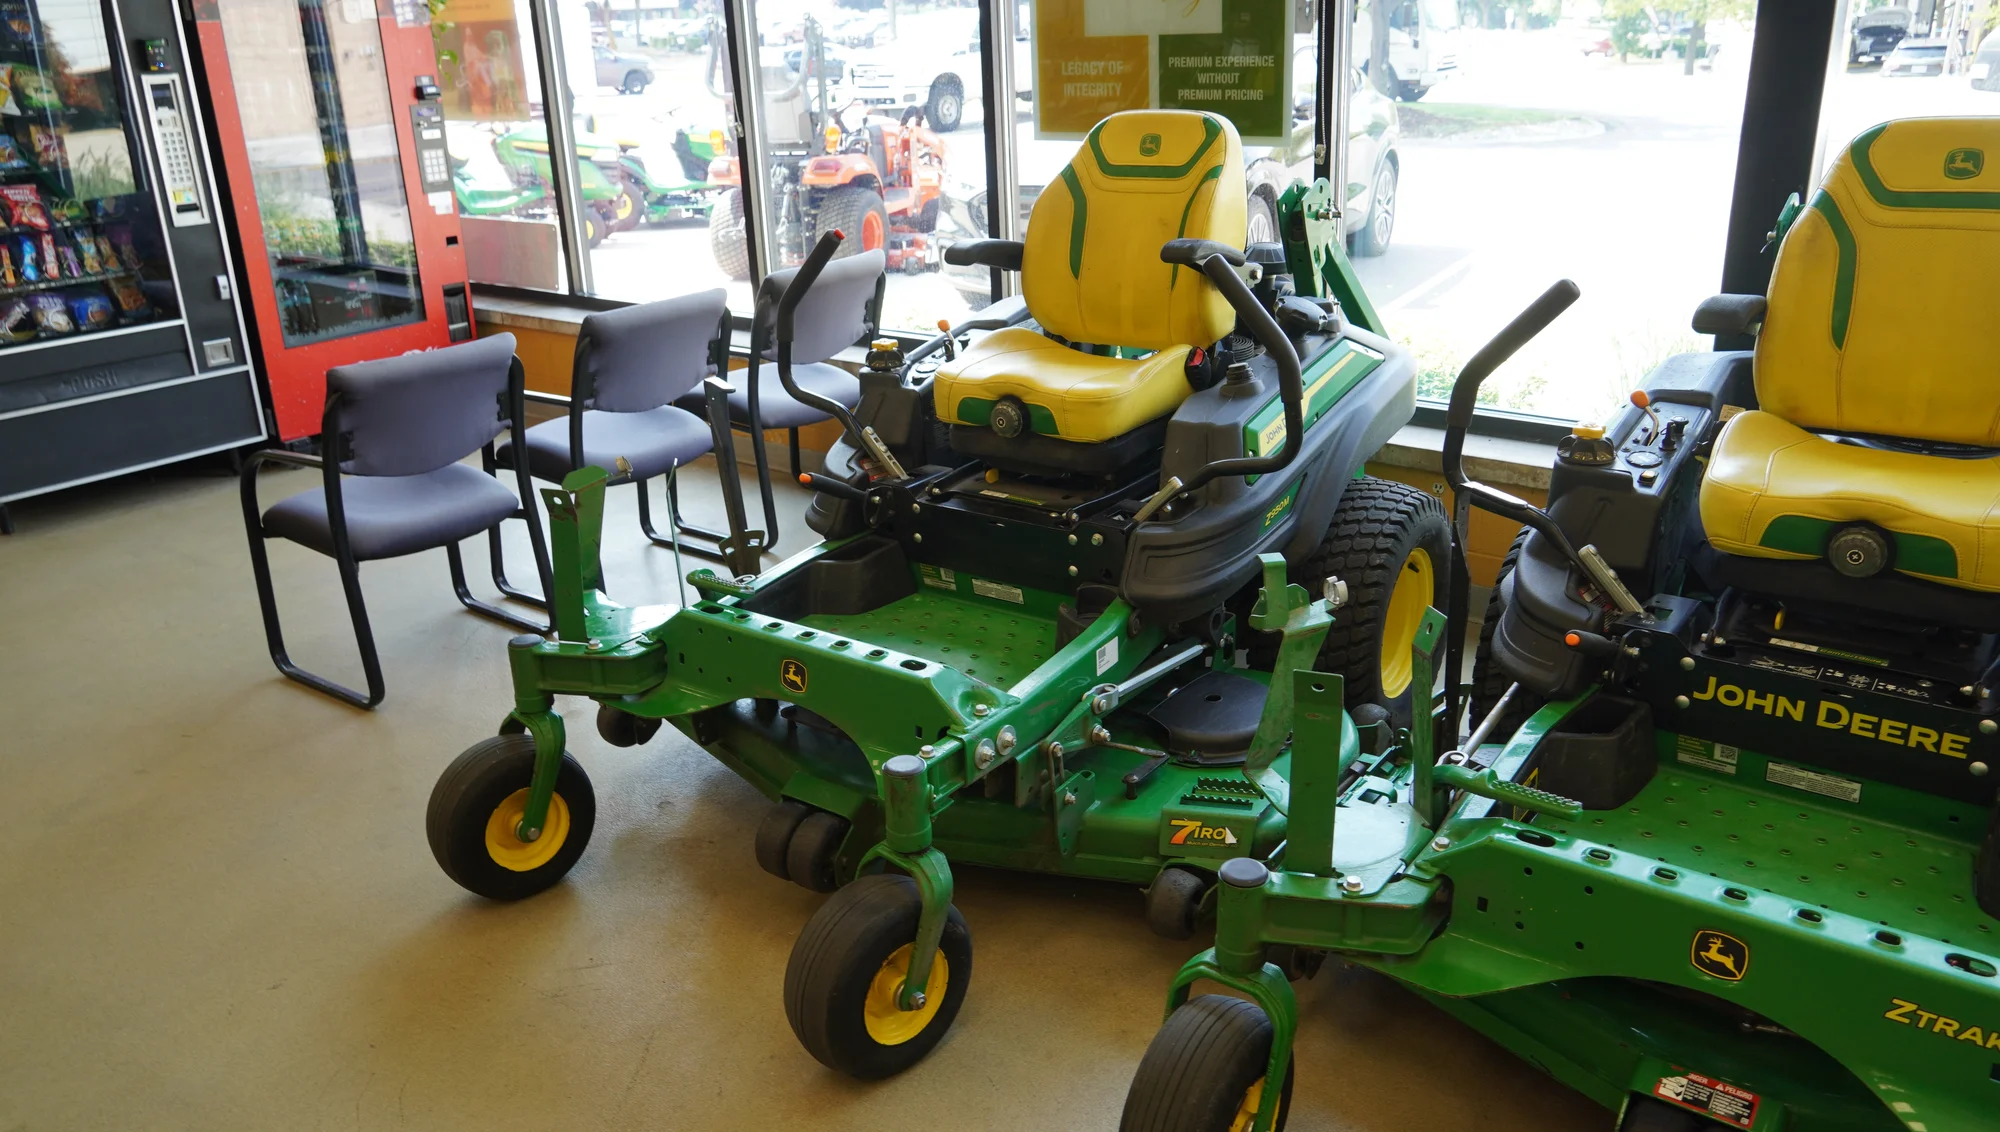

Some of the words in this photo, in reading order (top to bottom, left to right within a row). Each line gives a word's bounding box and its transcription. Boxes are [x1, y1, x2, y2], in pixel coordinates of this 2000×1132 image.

[1061, 62, 1104, 76] LEGACY
[1108, 61, 1124, 76] OF
[1168, 56, 1213, 68] PREMIUM
[1215, 55, 1275, 67] EXPERIENCE
[1198, 72, 1240, 84] WITHOUT
[1063, 82, 1122, 97] INTEGRITY
[1178, 89, 1222, 101] PREMIUM
[1225, 89, 1264, 101] PRICING
[1265, 423, 1284, 445] JOHN
[1692, 676, 1807, 723] JOHN
[1816, 700, 1971, 760] DEERE
[1170, 819, 1238, 845] 7IRO
[1724, 1085, 1754, 1101] PELIGRO
